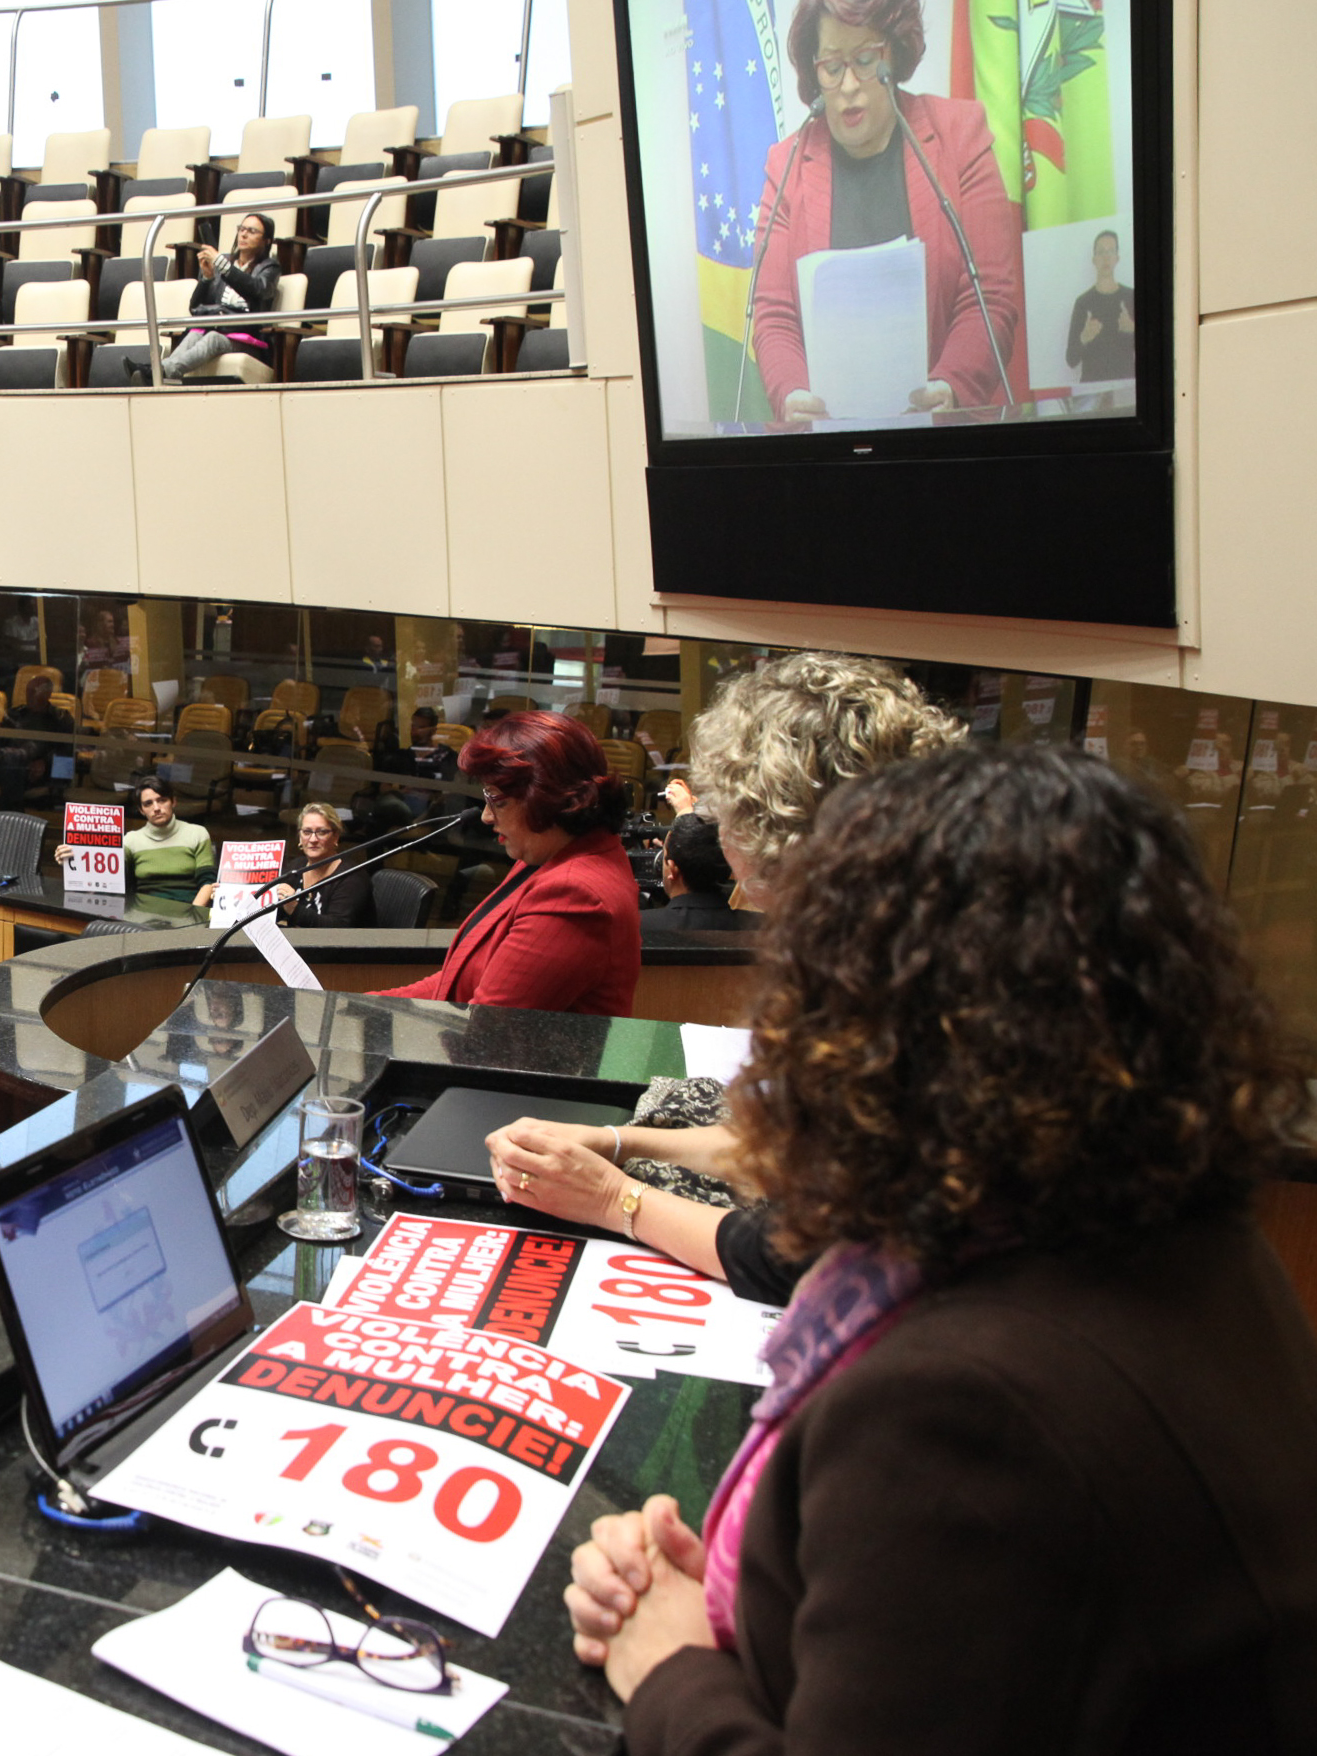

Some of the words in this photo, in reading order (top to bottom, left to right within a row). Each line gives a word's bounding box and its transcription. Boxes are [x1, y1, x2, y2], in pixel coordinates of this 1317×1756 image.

[66, 832, 121, 846] DENUNCIE!
[67, 822, 74, 830] A
[76, 823, 121, 832] MULHER:
[69, 805, 120, 816] VIOLÊNCIA
[74, 814, 114, 824] CONTRA
[81, 851, 119, 874] 180
[227, 843, 282, 852] VIOLÊNCIA
[231, 852, 274, 860] CONTRA
[234, 860, 280, 869] MULHER:
[341, 1221, 432, 1313] VIOLÊNCIA
[395, 1237, 466, 1310] CONTRA
[439, 1230, 510, 1311] MULHER:
[483, 1235, 576, 1343] DENUNCIE!
[590, 1254, 713, 1327] 180
[267, 1340, 307, 1361] A
[323, 1350, 585, 1439] MULHER:
[311, 1308, 601, 1400] VIOLÊNCIA
[323, 1332, 554, 1402] CONTRA
[238, 1358, 574, 1476] DENUNCIE!
[278, 1423, 523, 1543] 180
